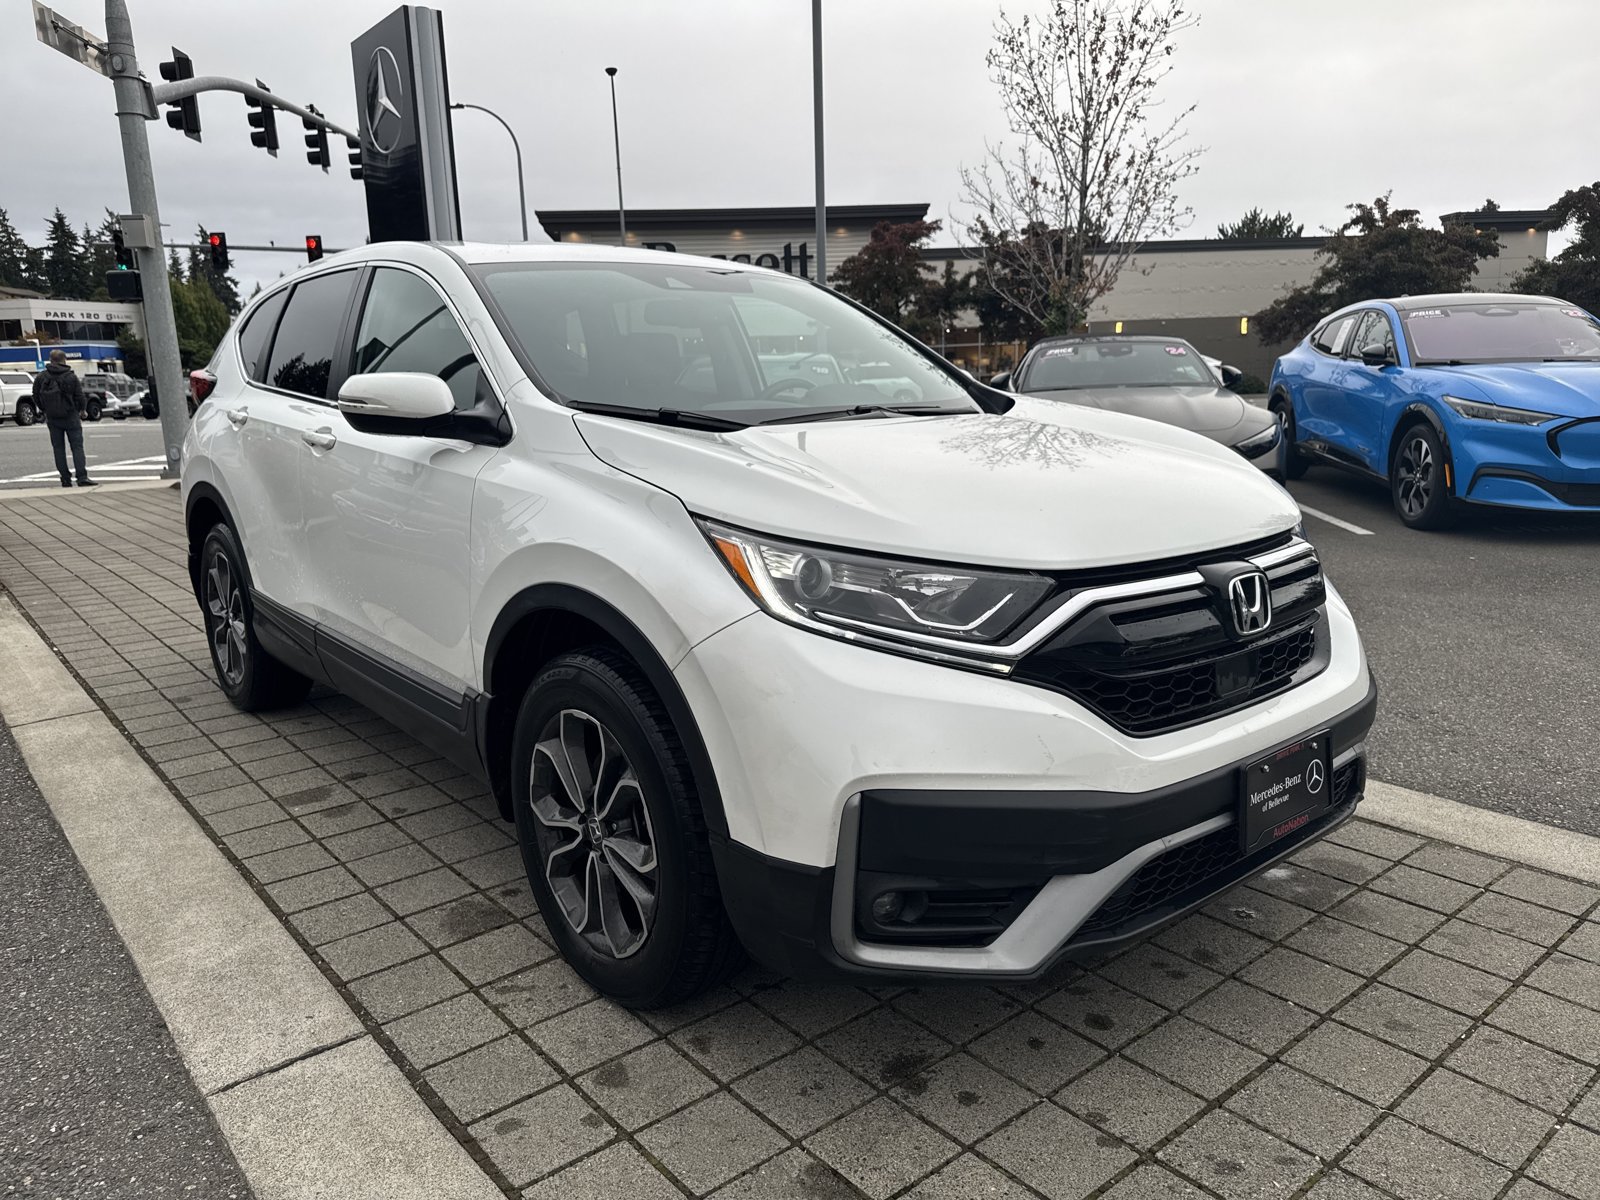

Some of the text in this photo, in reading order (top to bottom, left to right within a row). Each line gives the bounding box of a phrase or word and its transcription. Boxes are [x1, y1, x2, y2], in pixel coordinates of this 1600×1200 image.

[45, 311, 75, 319] PARK
[80, 312, 100, 320] 120
[1250, 774, 1302, 807] Mercedes-Benz
[1268, 794, 1290, 810] Bellevue
[1273, 814, 1309, 838] AutoNation
